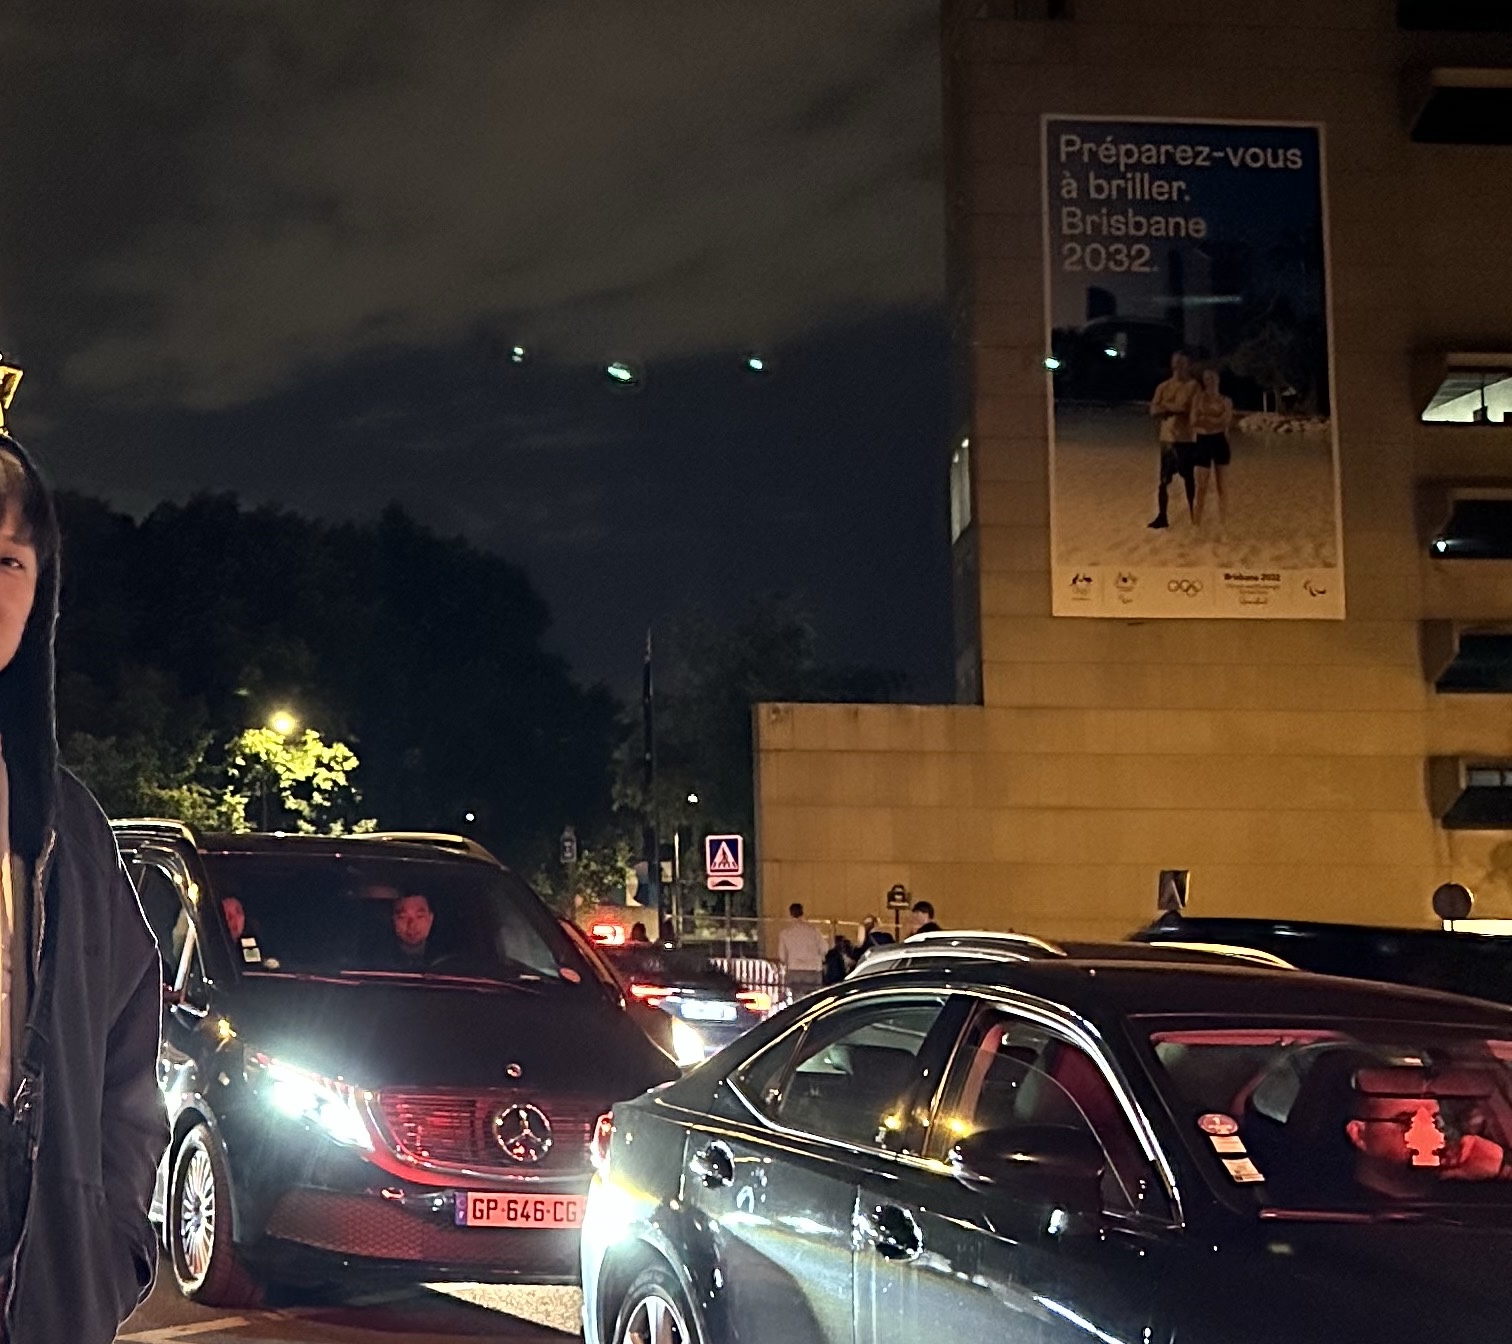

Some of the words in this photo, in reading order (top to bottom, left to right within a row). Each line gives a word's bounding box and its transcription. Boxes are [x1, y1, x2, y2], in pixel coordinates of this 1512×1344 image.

[1059, 133, 1304, 172] Préparez-vous
[1060, 170, 1078, 199] à
[1089, 171, 1191, 201] briller.
[1061, 206, 1207, 238] Brisbane
